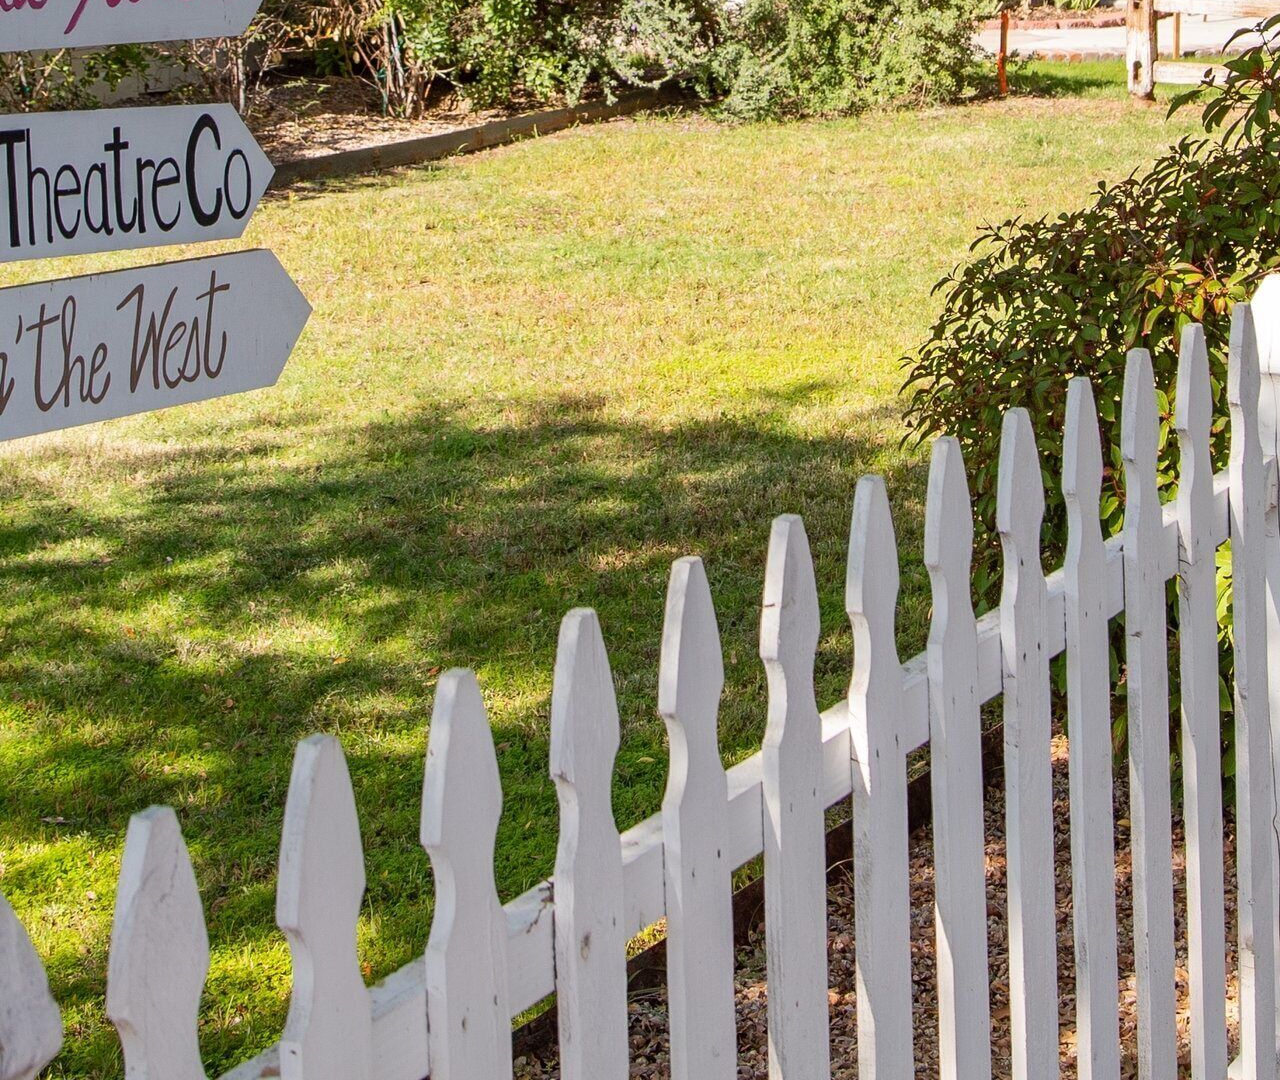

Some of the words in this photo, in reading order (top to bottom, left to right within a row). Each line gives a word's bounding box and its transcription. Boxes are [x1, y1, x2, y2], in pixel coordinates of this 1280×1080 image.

[186, 113, 252, 226] Co
[27, 295, 111, 413] the
[116, 271, 230, 394] West
